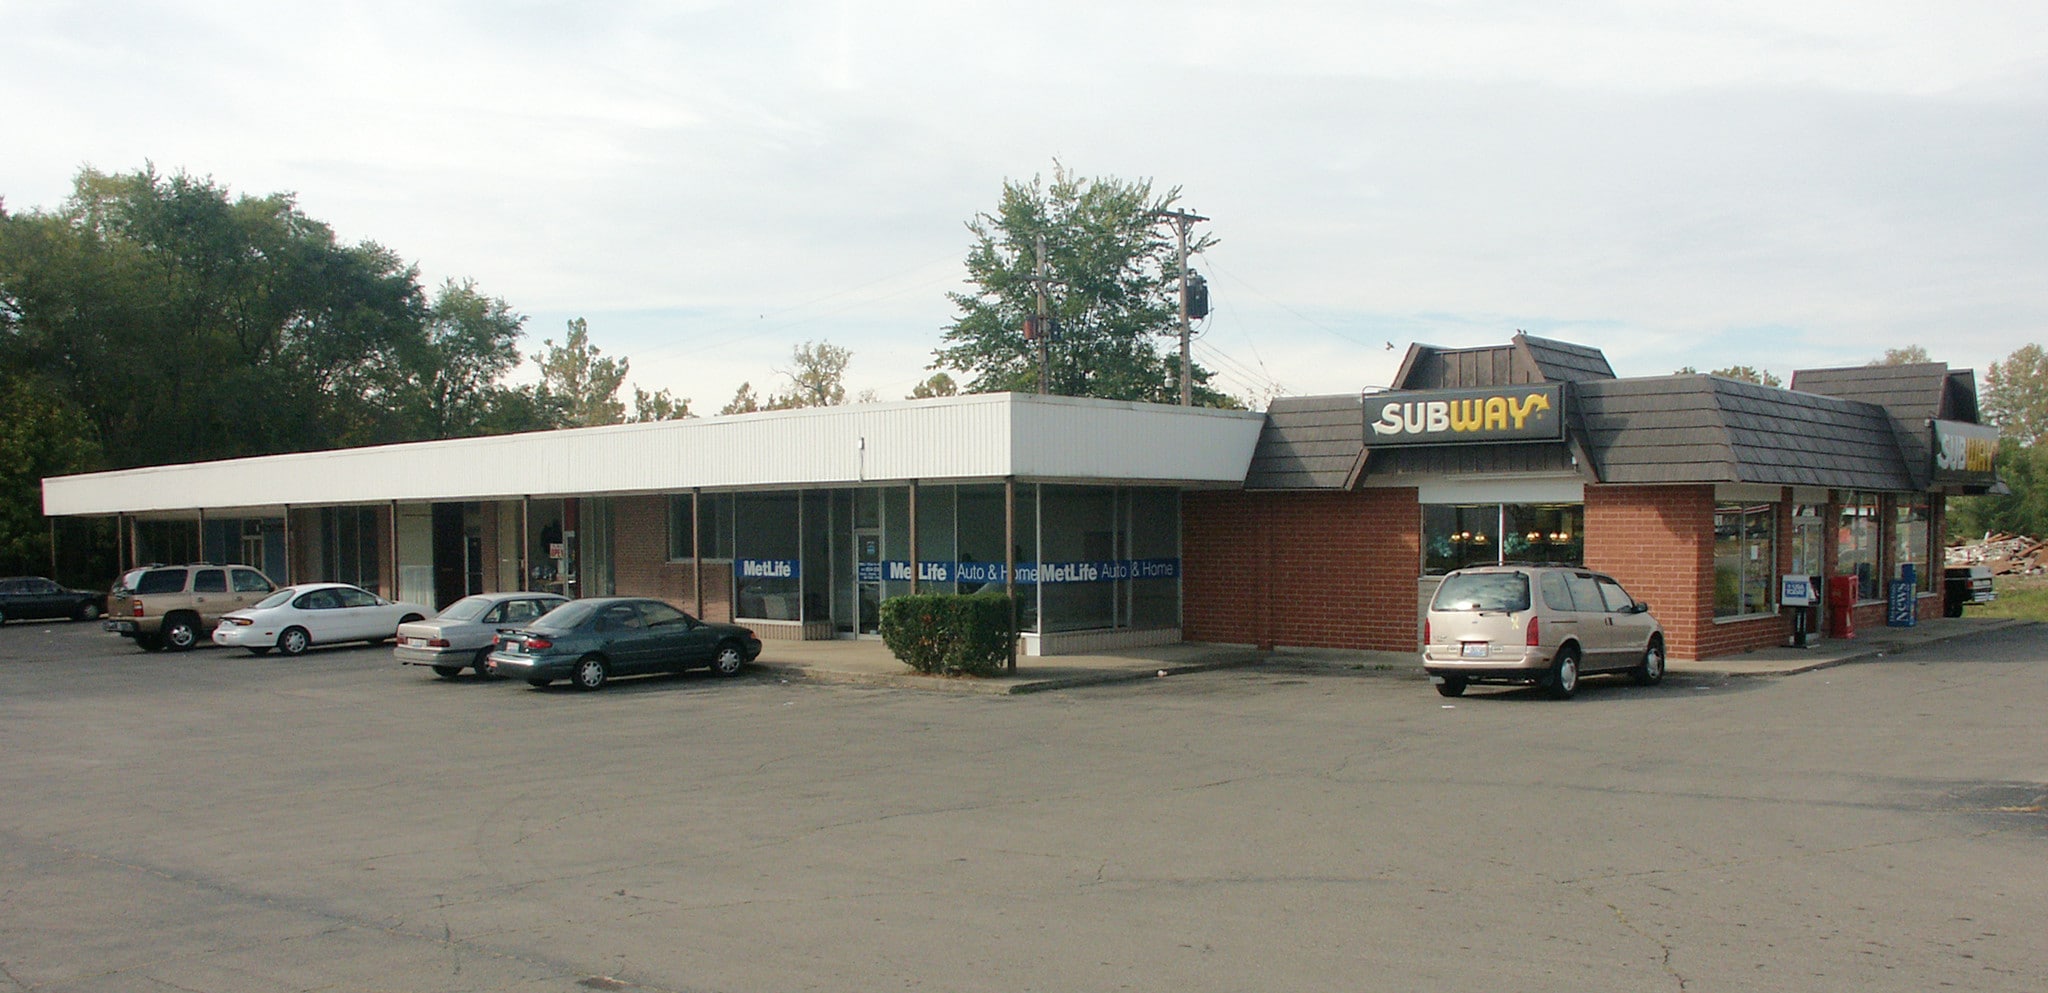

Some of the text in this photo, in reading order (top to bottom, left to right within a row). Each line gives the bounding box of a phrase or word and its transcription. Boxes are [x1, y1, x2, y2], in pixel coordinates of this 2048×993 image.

[1371, 393, 1550, 436] SUBWAY
[1937, 432, 1999, 471] SUBWAY
[743, 560, 791, 577] MetLife
[889, 562, 947, 580] MeLife
[957, 564, 984, 580] Auto
[988, 564, 997, 580] &
[1041, 562, 1173, 582] MetLife Auto & Home
